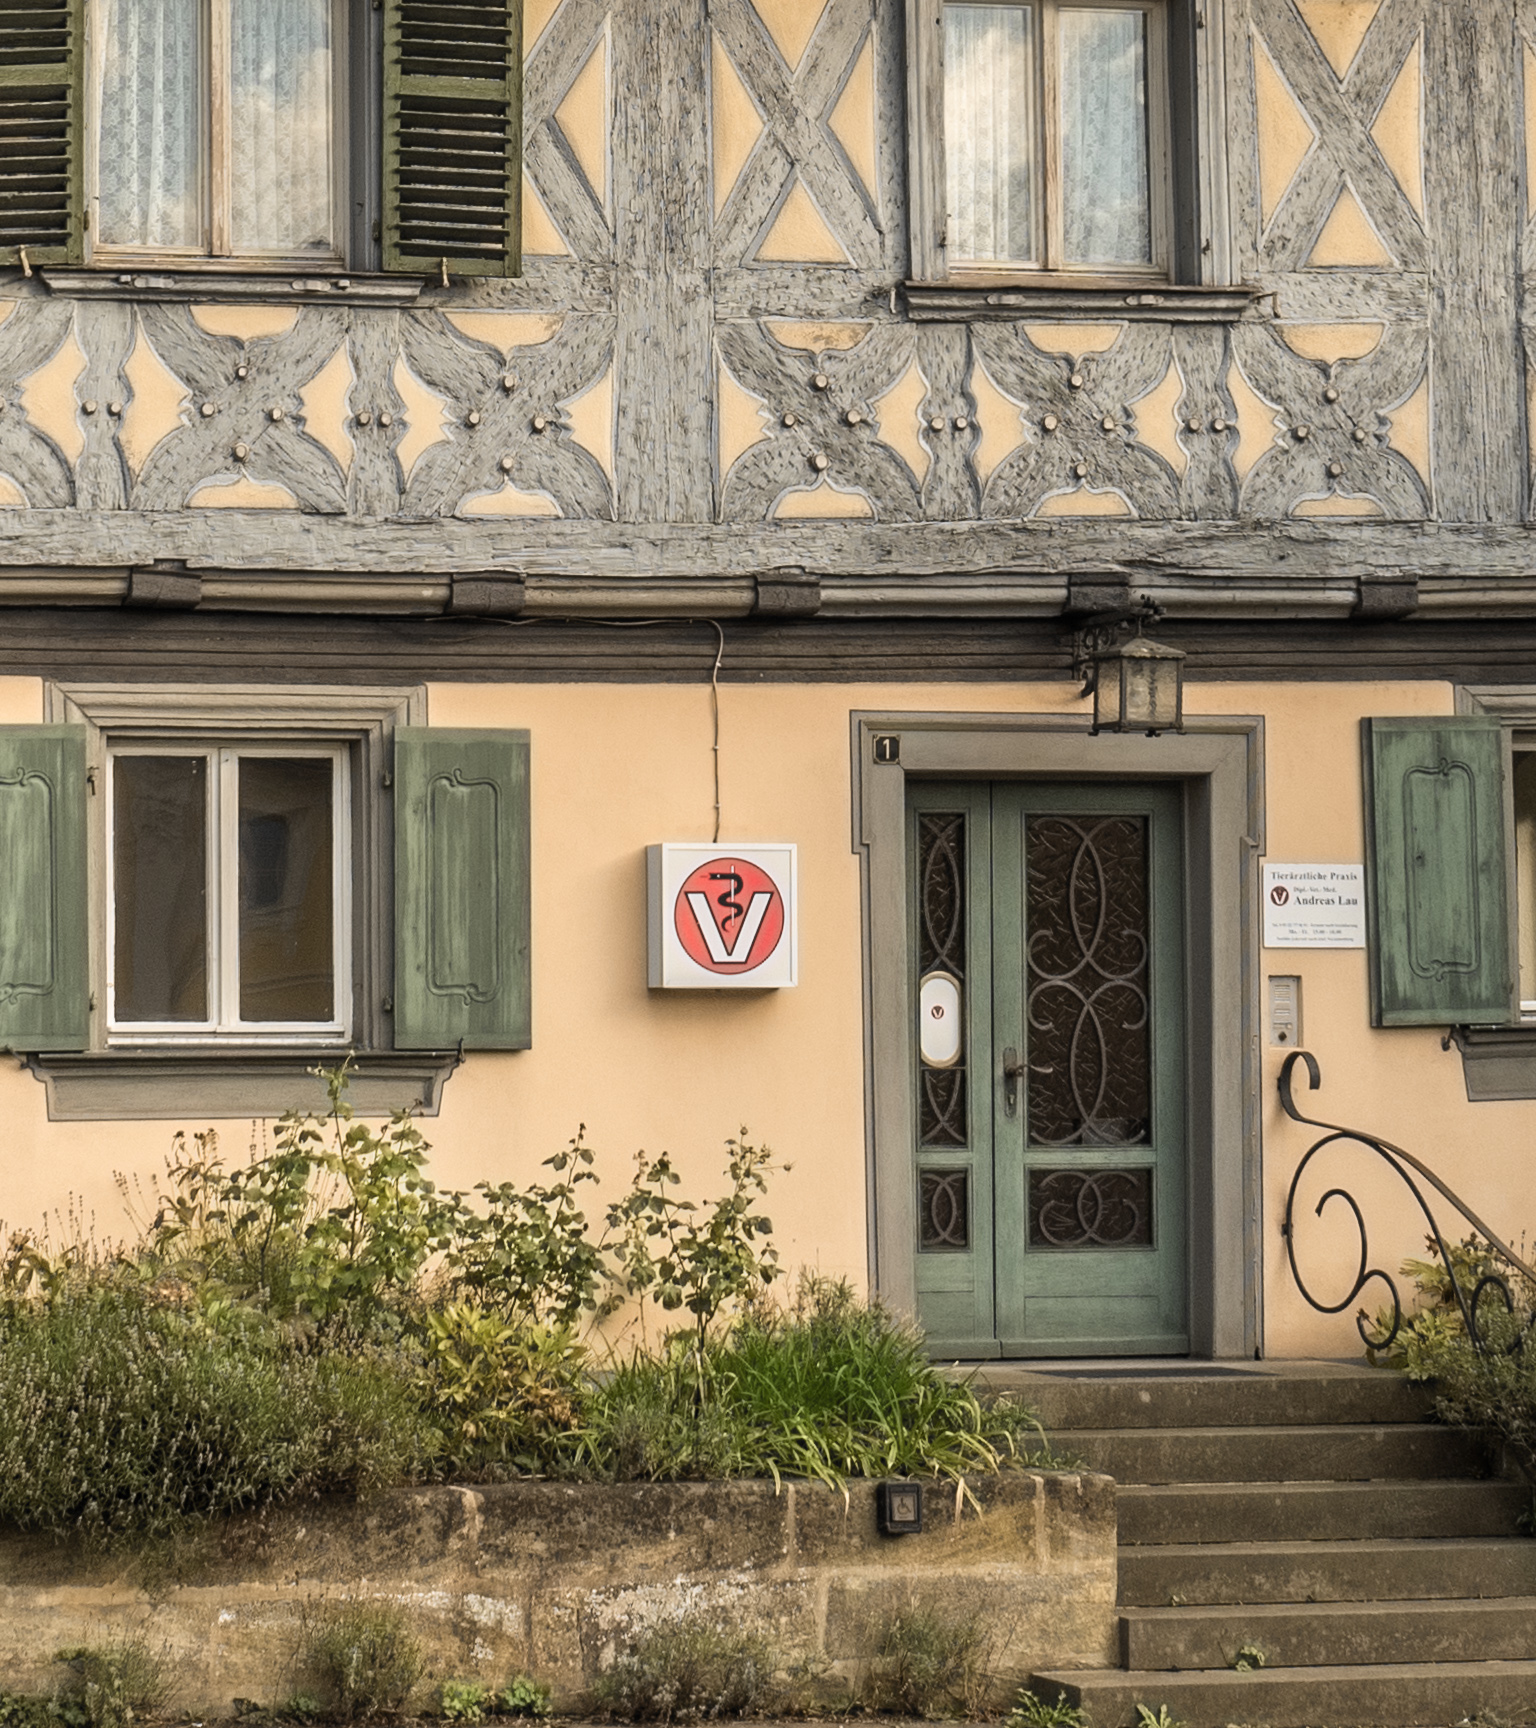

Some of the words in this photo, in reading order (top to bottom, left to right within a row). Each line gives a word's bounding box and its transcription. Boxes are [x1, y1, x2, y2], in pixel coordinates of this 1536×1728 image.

[882, 738, 889, 759] 1
[1271, 871, 1327, 881] Tierärztliche
[1330, 872, 1358, 881] Praxis
[1294, 896, 1335, 905] Andreas
[1338, 896, 1358, 905] Lau
